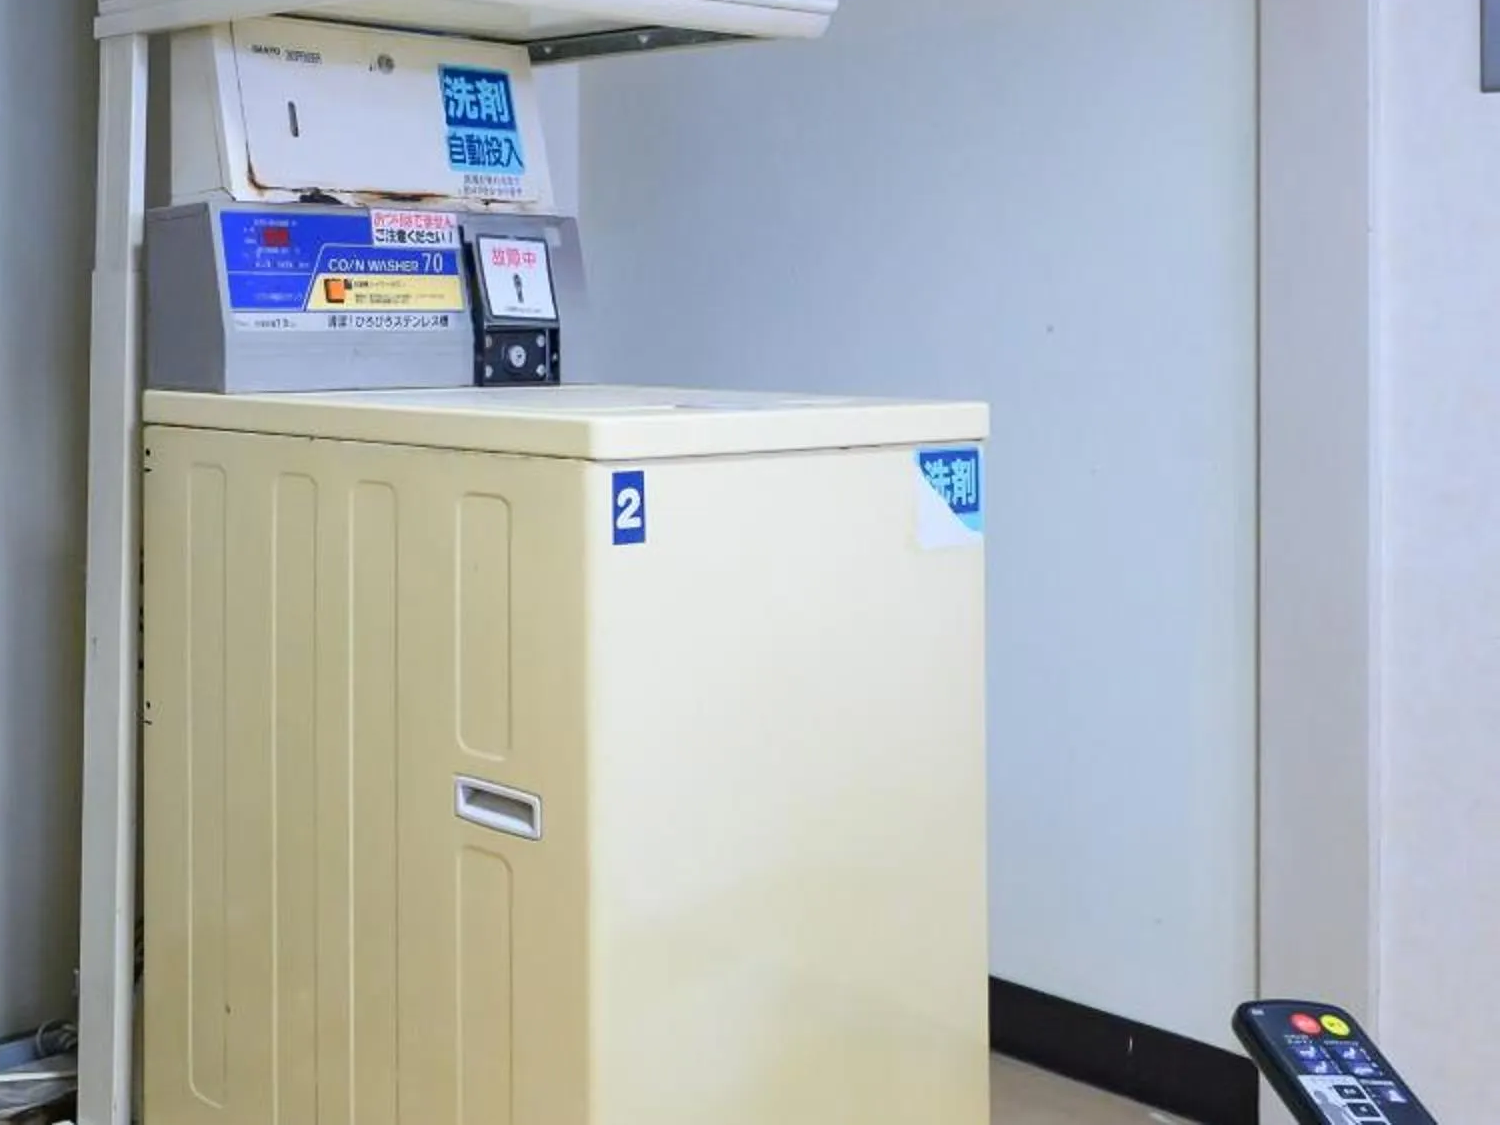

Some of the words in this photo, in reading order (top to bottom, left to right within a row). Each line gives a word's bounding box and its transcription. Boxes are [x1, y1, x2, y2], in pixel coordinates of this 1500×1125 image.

[445, 75, 511, 123] 洗剤
[448, 132, 525, 169] 自動投入
[367, 260, 419, 272] WASHER
[421, 253, 443, 273] 70
[616, 487, 642, 531] 2
